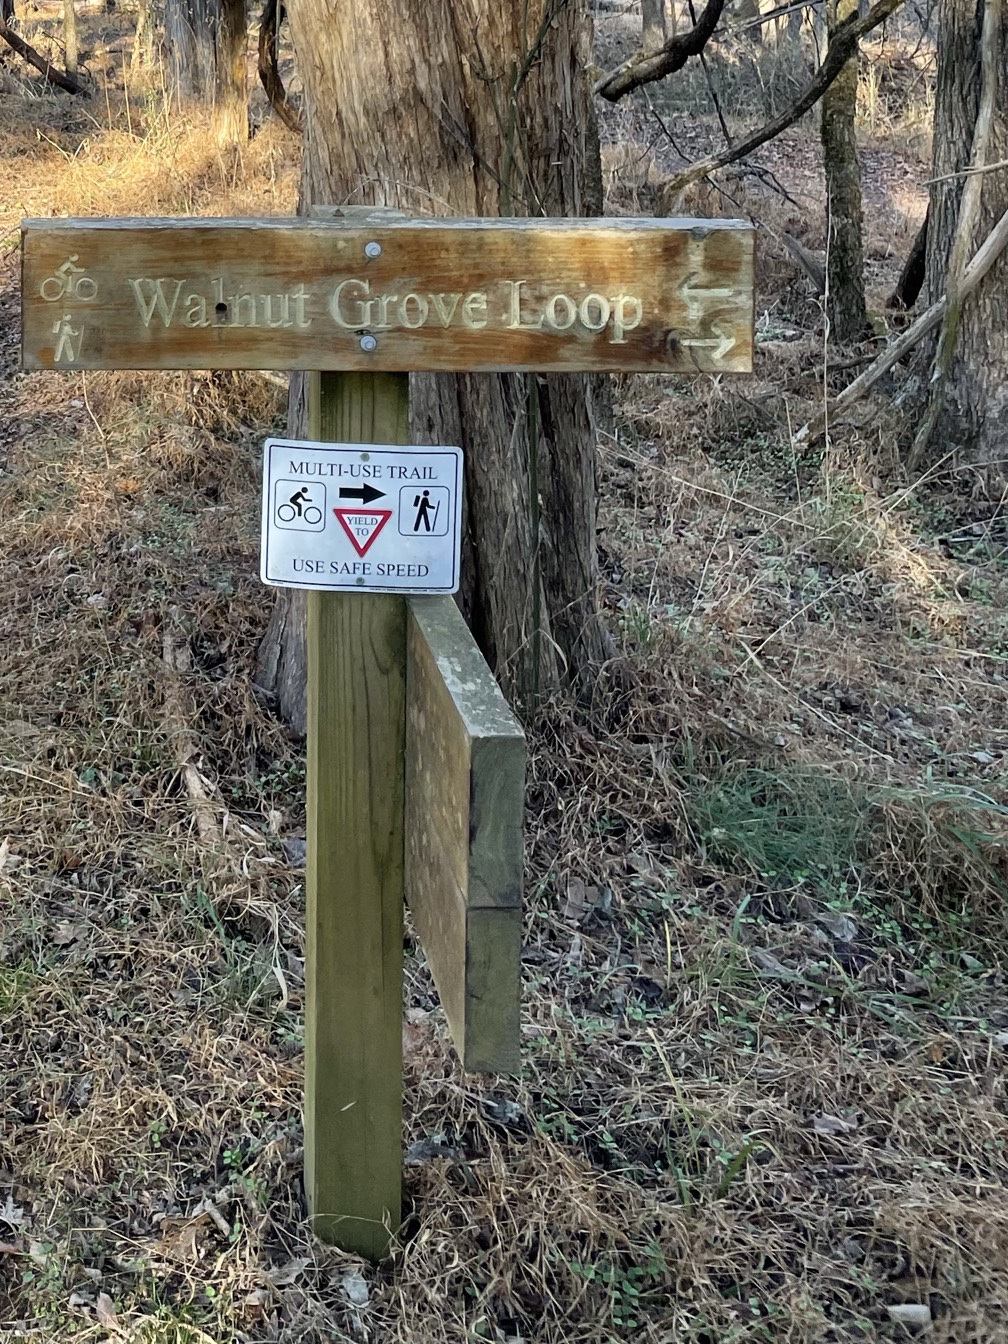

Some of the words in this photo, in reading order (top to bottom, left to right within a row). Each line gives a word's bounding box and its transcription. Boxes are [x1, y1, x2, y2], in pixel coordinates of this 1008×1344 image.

[128, 276, 313, 329] Walnut
[329, 277, 489, 330] Grove
[504, 279, 644, 344] Loop
[288, 460, 382, 479] MULTI-USE
[387, 466, 438, 480] TRAIL
[346, 515, 379, 527] YIELD
[354, 527, 370, 537] TO
[292, 558, 325, 574] USE
[329, 560, 372, 577] SAFE
[376, 562, 430, 578] SPEED
